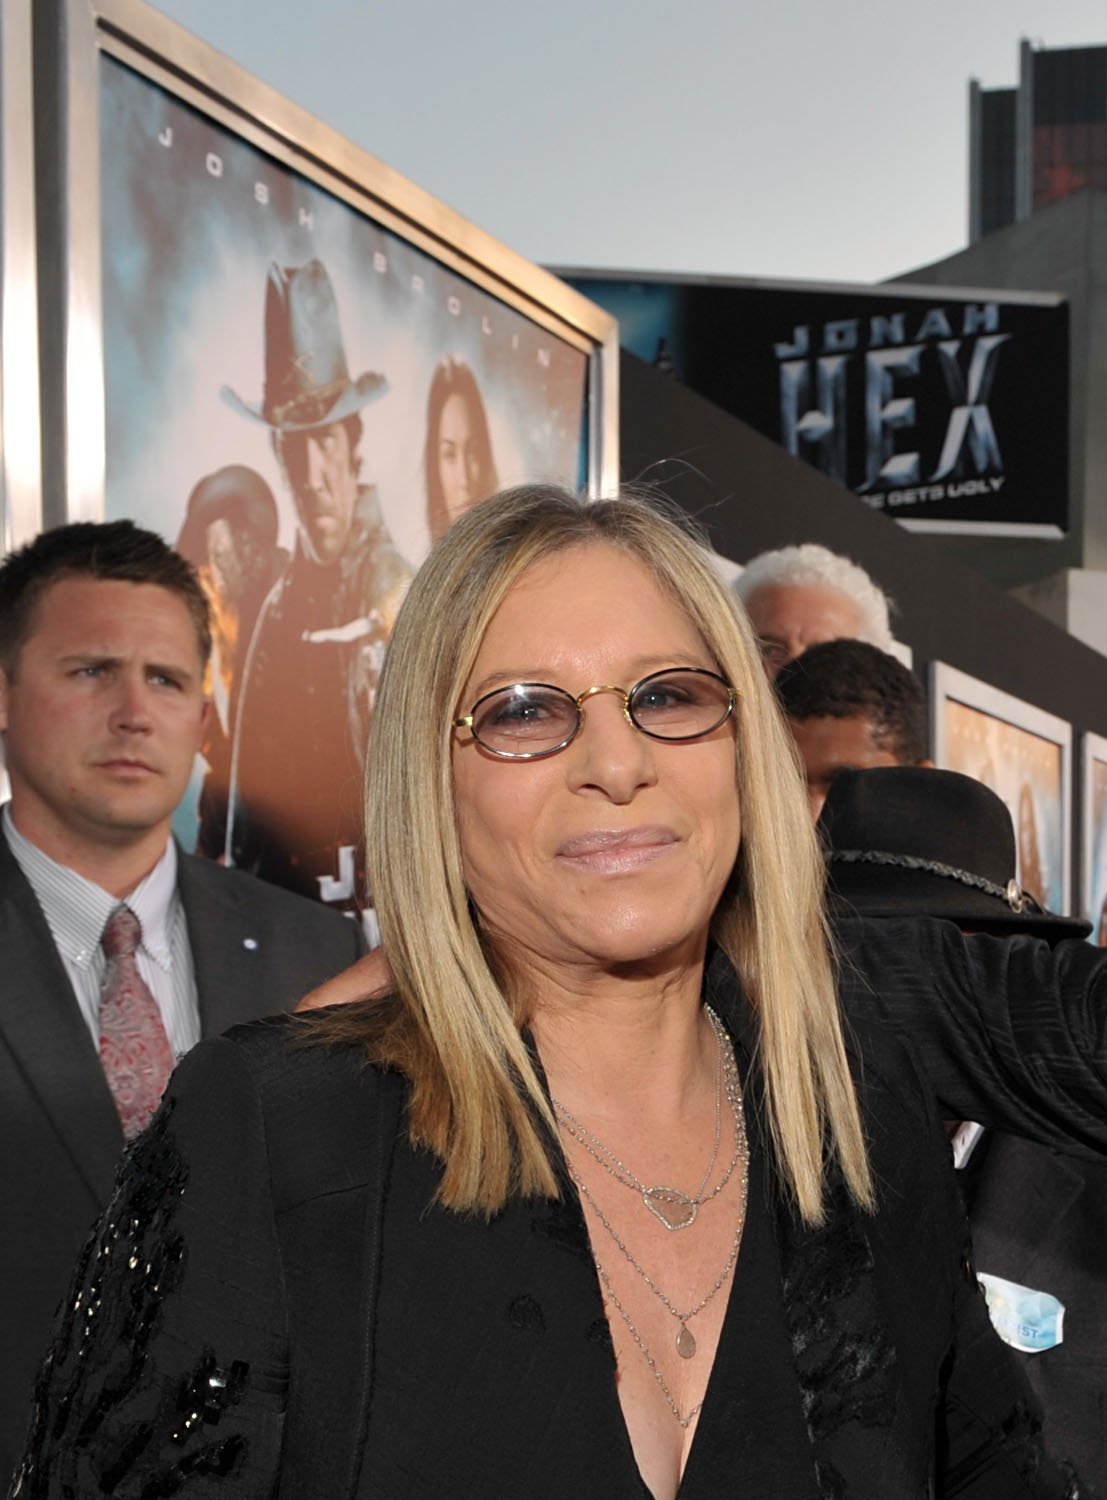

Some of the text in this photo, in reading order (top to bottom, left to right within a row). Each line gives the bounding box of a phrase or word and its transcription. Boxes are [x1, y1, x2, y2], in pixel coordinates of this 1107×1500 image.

[158, 127, 549, 367] JOSH BROLIN
[774, 303, 1000, 359] JONAH
[780, 333, 1012, 492] HEX
[887, 484, 944, 506] GETS
[947, 475, 1005, 498] UGLY
